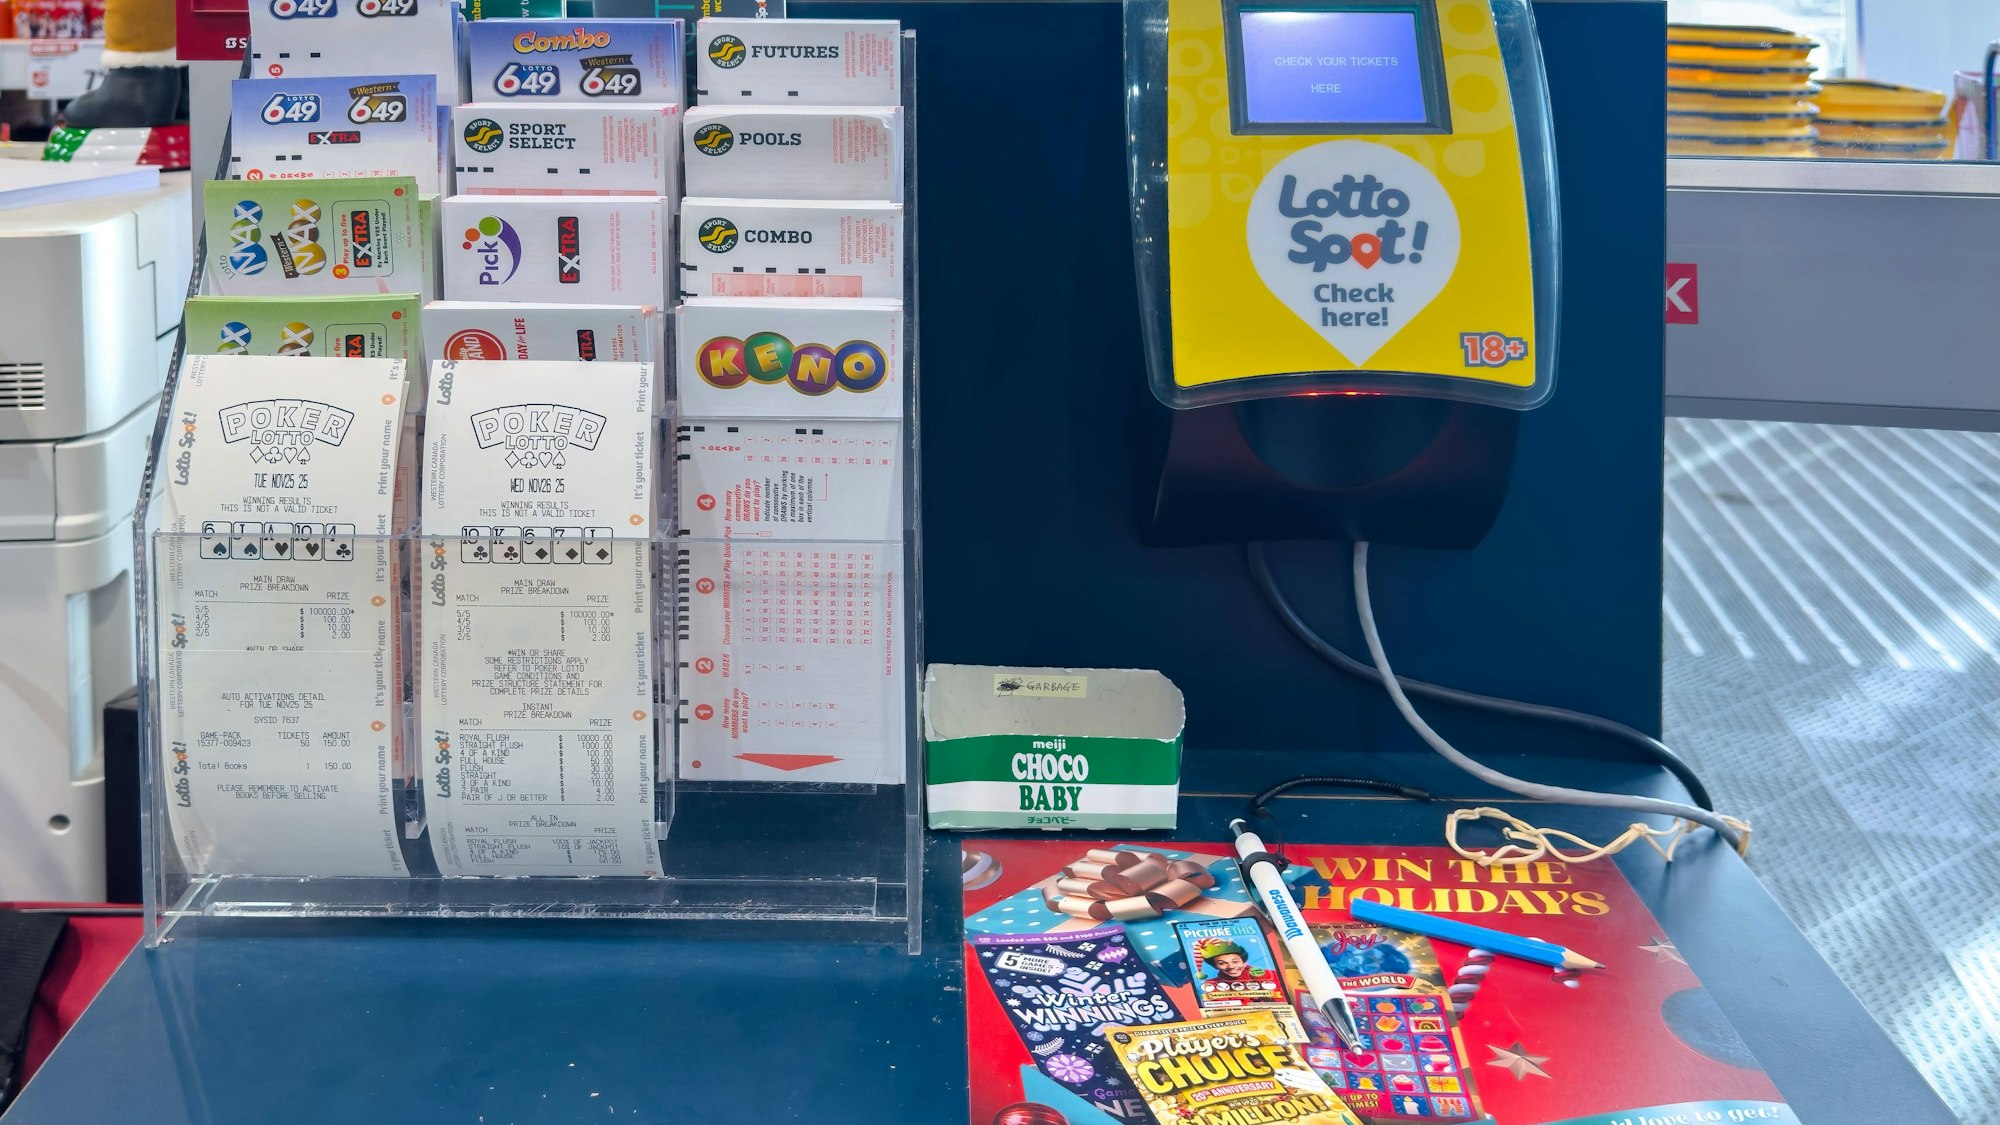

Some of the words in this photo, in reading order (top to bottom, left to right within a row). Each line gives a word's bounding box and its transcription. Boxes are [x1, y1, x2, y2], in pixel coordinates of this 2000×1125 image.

[513, 27, 610, 53] Combo
[713, 36, 735, 46] SPORT
[751, 46, 839, 59] FUTURES
[588, 57, 625, 67] Western
[716, 55, 743, 68] SELECT
[1274, 56, 1313, 67] CHECK
[1316, 56, 1346, 67] YOUR
[1350, 56, 1398, 67] TICKETS
[497, 65, 557, 94] 649
[583, 68, 636, 95] 649
[356, 84, 393, 96] Western
[1311, 84, 1341, 93] HERE
[264, 96, 318, 122] 649
[350, 95, 404, 122] 649
[469, 120, 492, 131] SPORT
[509, 123, 566, 136] SPORT
[699, 125, 723, 135] SPORT
[309, 131, 360, 145] EXTRA
[509, 138, 576, 149] SELECT
[739, 133, 802, 146] POOLS
[472, 139, 501, 153] SELECT
[702, 142, 731, 155] SELECT
[1278, 174, 1411, 218] Lotto
[703, 219, 727, 230] SPORT
[229, 204, 267, 274] MAX
[287, 204, 325, 274] MAX
[343, 238, 349, 246] up
[351, 211, 375, 266] EXTRA
[744, 230, 813, 244] COMBO
[559, 217, 581, 283] EXTRA
[706, 239, 735, 252] SELECT
[1287, 219, 1429, 273] Spot!
[277, 240, 295, 277] Western
[477, 241, 499, 285] Pick
[219, 254, 236, 280] Lotto
[1314, 283, 1395, 303] Check
[1322, 307, 1389, 326] here!
[514, 317, 525, 335] LIFE
[518, 341, 528, 359] DAY
[1462, 334, 1526, 365] 18+
[708, 342, 876, 386] KENO
[178, 411, 198, 449] Spot!
[226, 406, 346, 439] POKER
[479, 411, 599, 443] POKER
[250, 430, 314, 445] LOTTO
[382, 419, 392, 445] name
[505, 435, 568, 450] LOTTO
[380, 446, 391, 470] your
[174, 450, 192, 486] Lotto
[254, 473, 268, 488] TUE
[272, 473, 294, 488] NOV25
[299, 474, 308, 489] 25
[378, 472, 388, 495] Print
[511, 478, 524, 493] WED
[528, 478, 551, 493] NOV26
[555, 479, 565, 493] 25
[243, 496, 275, 504] WINNING
[279, 497, 312, 505] RESULTS
[501, 501, 533, 509] WINNING
[537, 501, 569, 509] RESULTS
[700, 497, 713, 508] 4
[221, 504, 238, 512] THIS
[243, 504, 252, 512] IS
[256, 504, 271, 513] NOT
[275, 505, 280, 513] A
[284, 505, 307, 514] VALID
[311, 506, 338, 514] TICKET
[479, 509, 497, 517] THIS
[502, 509, 511, 517] IS
[514, 509, 528, 517] NOT
[532, 509, 537, 517] A
[542, 509, 565, 518] VALID
[569, 509, 596, 518] TICKET
[514, 579, 533, 587] MAIN
[537, 579, 556, 587] DRAW
[501, 587, 524, 595] PRIZE
[528, 587, 569, 595] BREAKDOWN
[698, 660, 711, 671] 2
[722, 653, 730, 678] WAGER
[733, 687, 741, 700] you
[1026, 682, 1081, 692] GARBAGE
[222, 693, 240, 701] AUTO
[245, 693, 295, 701] ACTIVATIONS
[299, 693, 326, 701] DETAIL
[723, 697, 731, 712] many
[732, 700, 739, 708] do
[741, 691, 750, 710] play?
[522, 703, 554, 711] INSTANT
[697, 708, 711, 717] 1
[254, 716, 277, 724] SYSID
[282, 716, 300, 724] 7637
[504, 711, 527, 719] PRIZE
[531, 711, 572, 719] BREAKDOWN
[722, 713, 730, 728] How
[459, 719, 482, 727] MATCH
[589, 719, 612, 727] PRIZE
[731, 708, 739, 740] NUMBERS
[460, 734, 483, 742] ROYAL
[487, 734, 510, 742] FLUSH
[577, 734, 613, 742] 10000.00
[1033, 740, 1066, 752] meiji
[1011, 753, 1089, 782] CHOCO
[1019, 785, 1082, 811] BABY
[1027, 816, 1077, 825] チョコベビー
[1306, 857, 1433, 882] WIN
[1449, 857, 1573, 885] THE
[1304, 885, 1610, 916] HOLIDAYS
[1268, 889, 1304, 940] Wawanesa
[1183, 927, 1232, 938] PICTURE
[1233, 925, 1257, 935] THIS
[1004, 955, 1020, 968] 5
[1020, 965, 1051, 973] INSIDE!
[1021, 961, 1053, 969] GAMES
[1359, 975, 1407, 987] WORLD
[1035, 991, 1133, 1007] Winter
[1013, 995, 1169, 1025] WINNINGS
[1137, 1033, 1260, 1061] Player's
[1137, 1045, 1291, 1094] CHOICE
[1192, 1090, 1211, 1101] 20TH
[1211, 1081, 1275, 1097] ANNIVERSARY
[1203, 1095, 1330, 1125] MILLION!
[1696, 1110, 1722, 1123] to
[1728, 1106, 1780, 1123] get!
